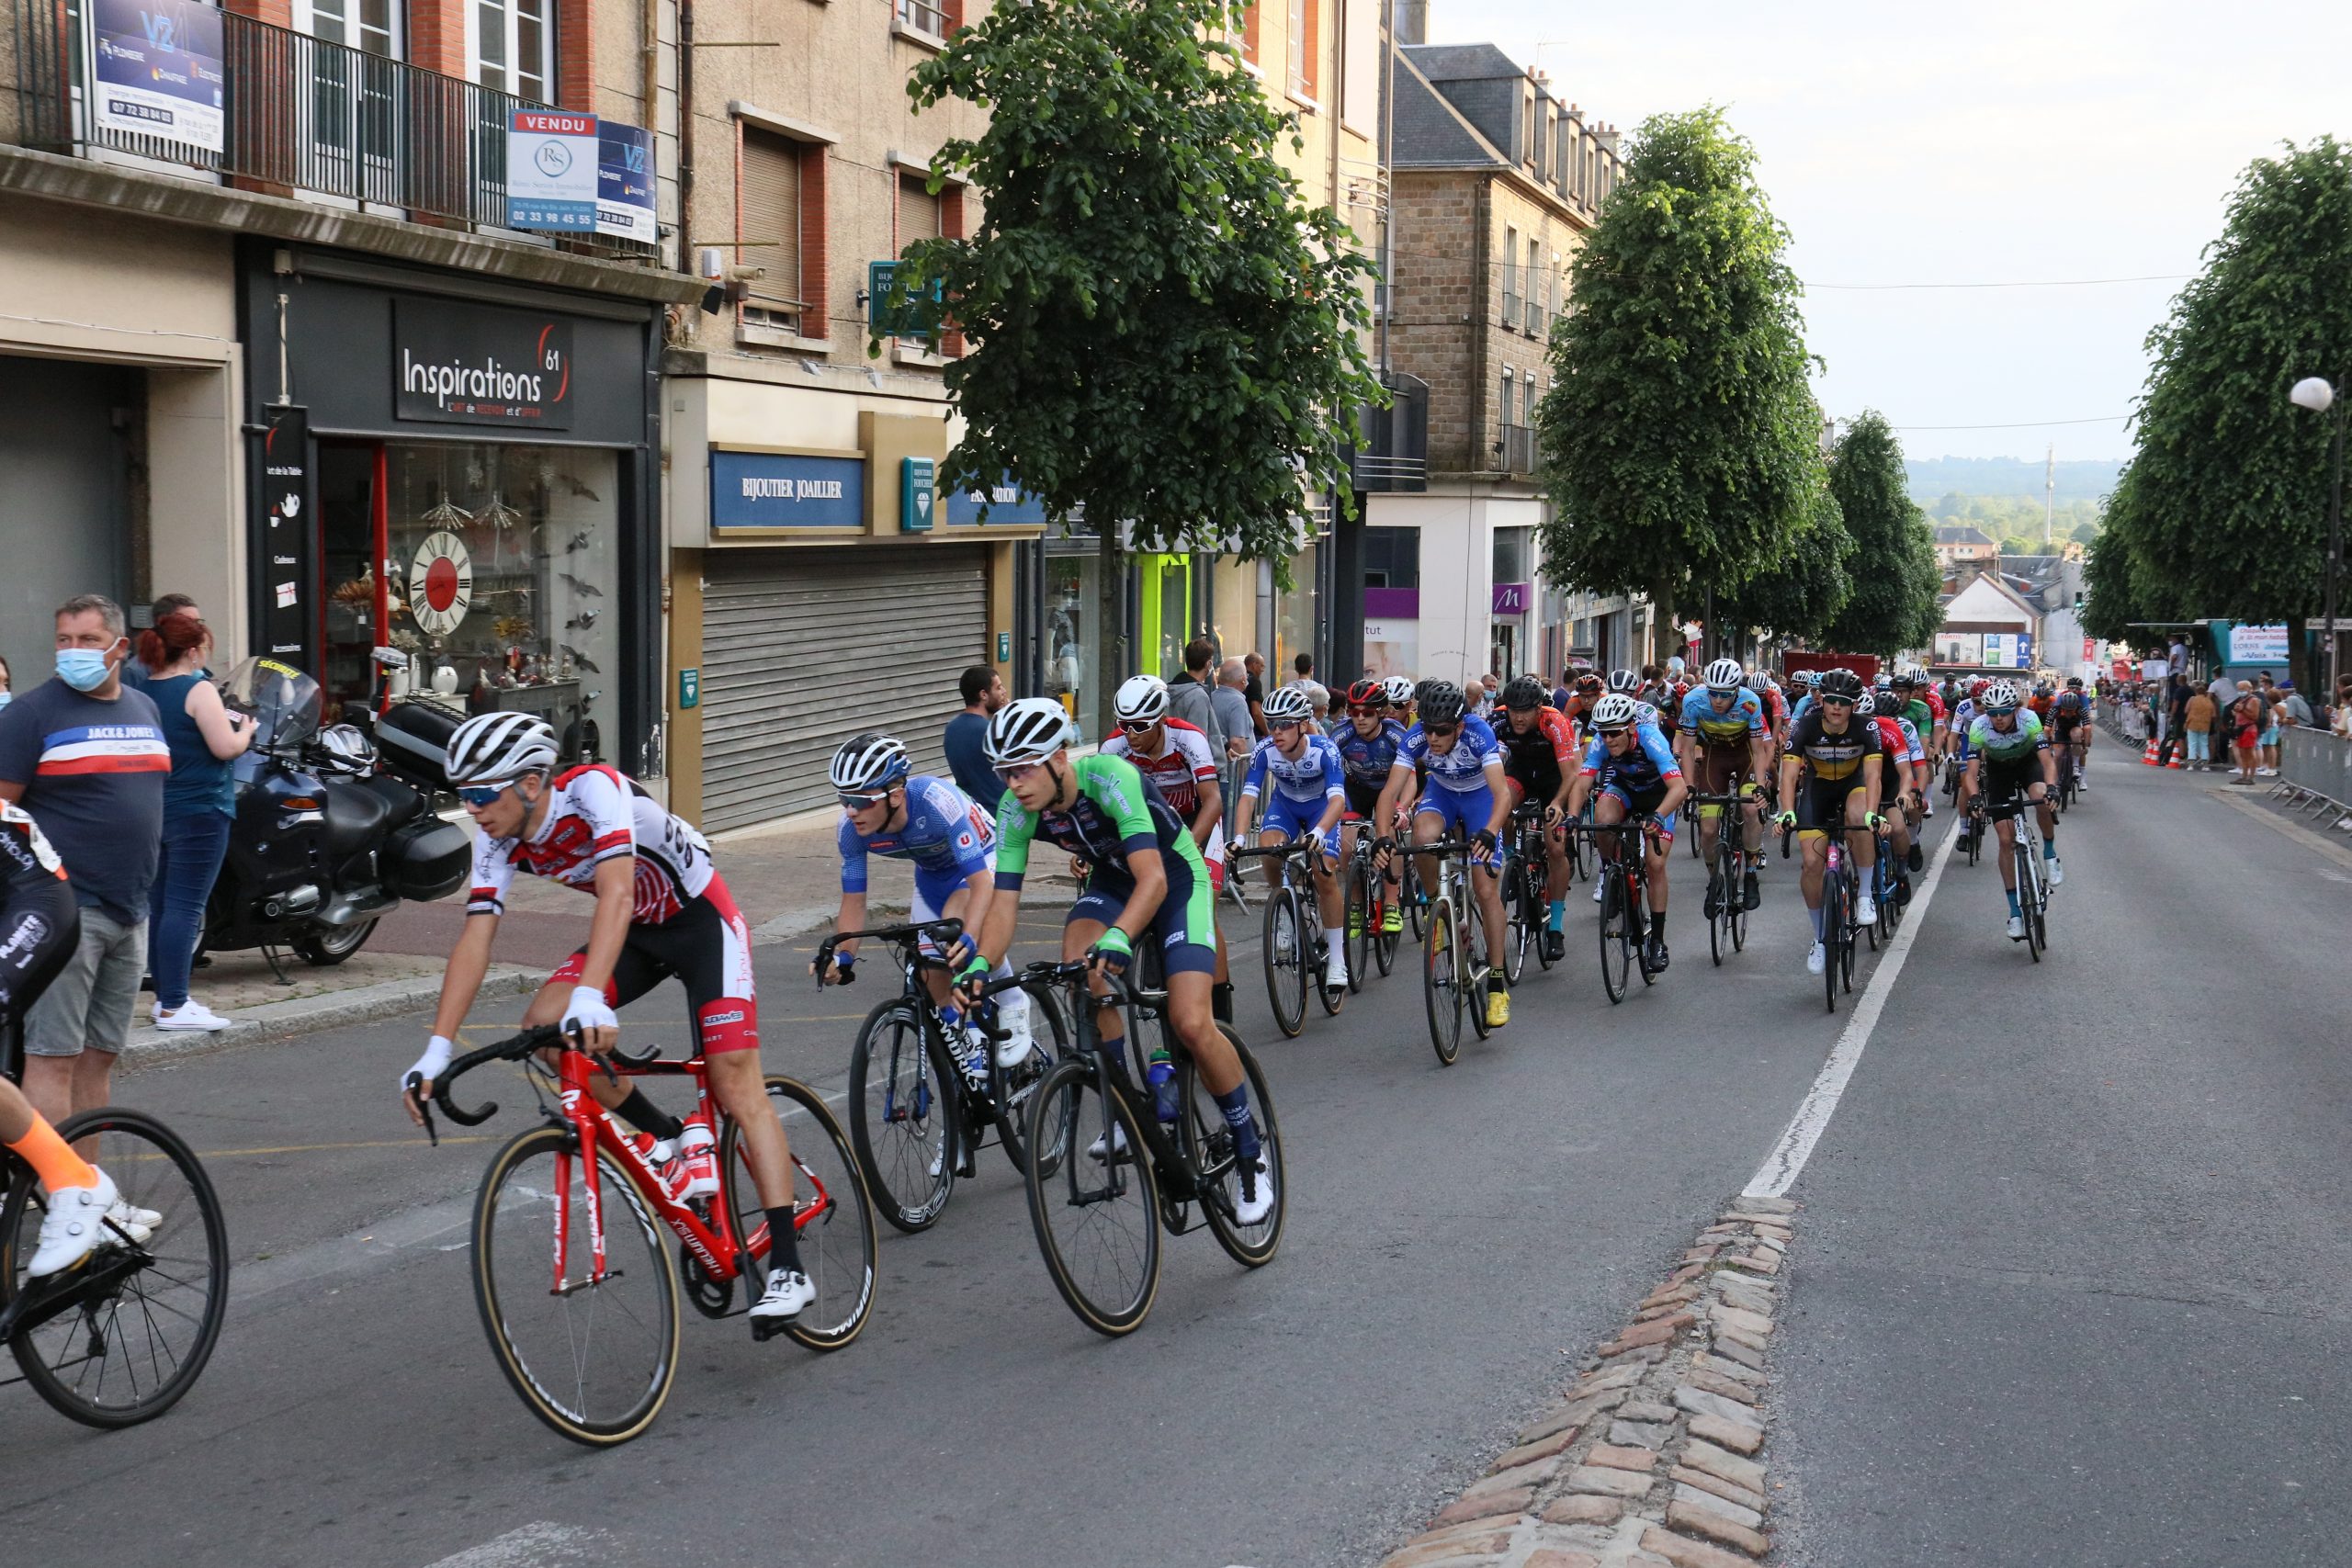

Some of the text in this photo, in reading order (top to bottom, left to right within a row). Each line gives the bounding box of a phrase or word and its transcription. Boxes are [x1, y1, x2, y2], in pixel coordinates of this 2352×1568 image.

[112, 102, 125, 113] 07
[127, 105, 138, 117] 72
[139, 107, 150, 118] 38
[526, 116, 585, 132] VENDU
[513, 210, 592, 225] 02 33 98 45 55
[545, 348, 560, 372] 61
[403, 347, 542, 409] Inspirations
[467, 402, 476, 413] de
[506, 407, 514, 416] et
[742, 477, 842, 503] BIJOUTIER JOAILLIER
[929, 1005, 981, 1092] S-WORKS
